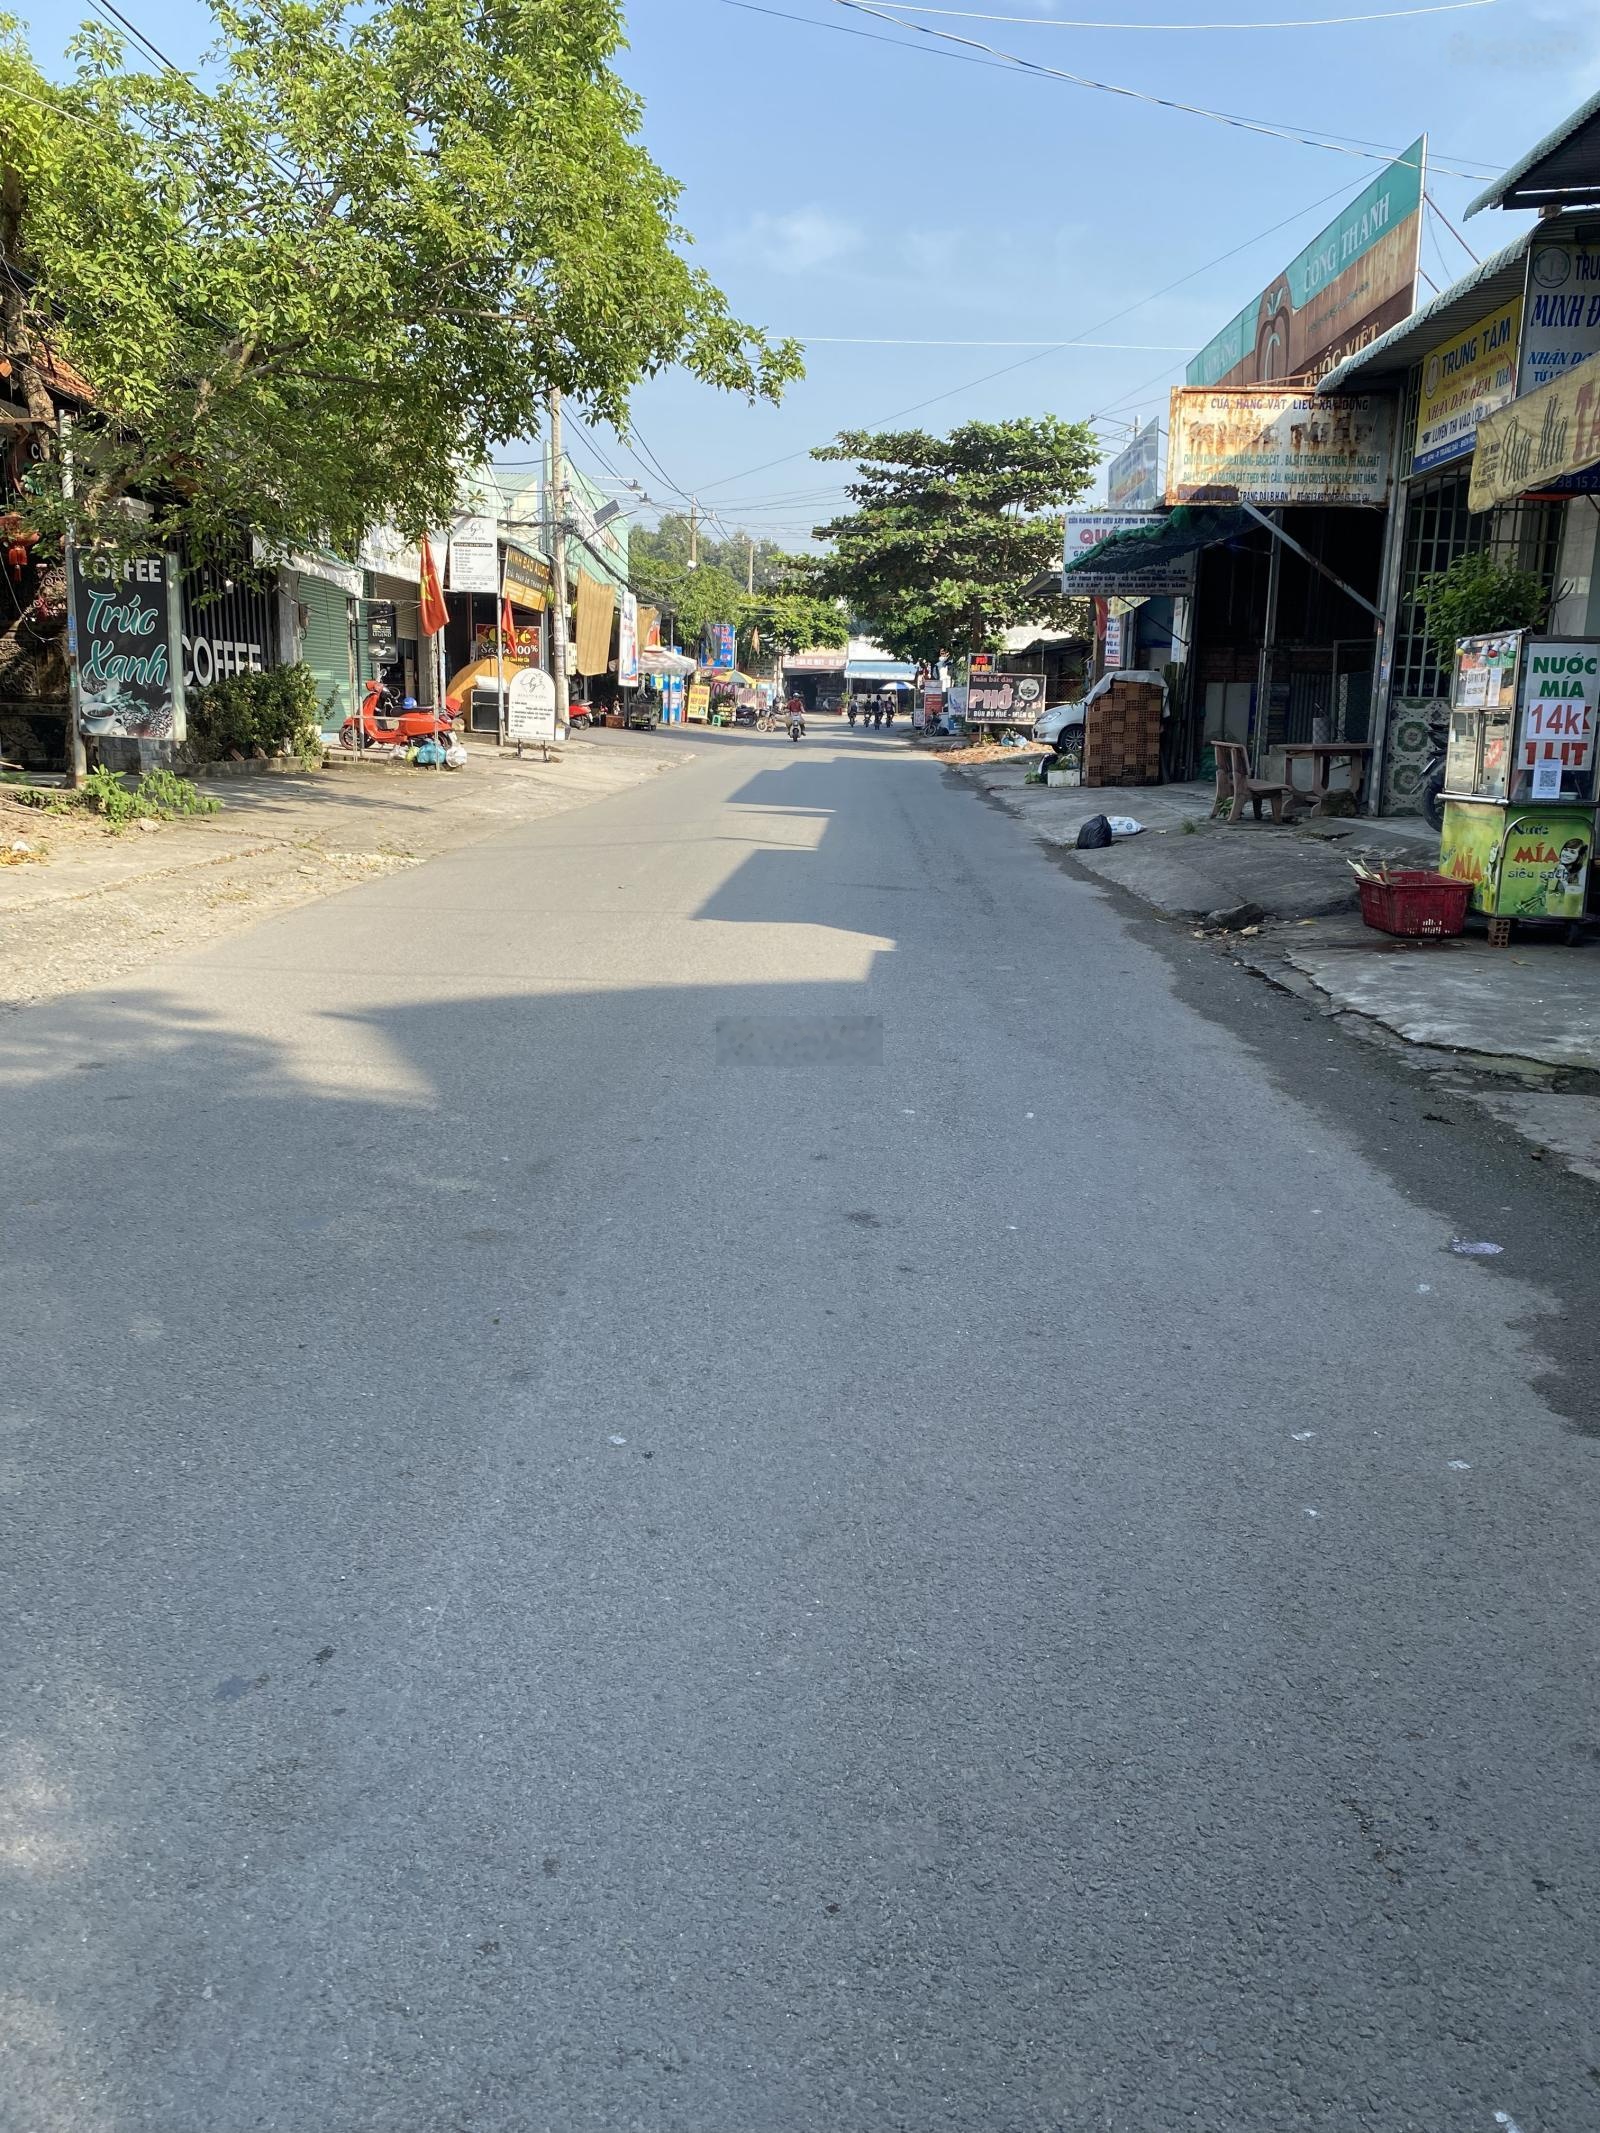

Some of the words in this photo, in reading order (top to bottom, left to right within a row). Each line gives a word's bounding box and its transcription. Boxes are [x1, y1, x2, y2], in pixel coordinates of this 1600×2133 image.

[1530, 294, 1585, 328] MINH
[1442, 335, 1478, 378] TRUNG
[1482, 316, 1511, 356] TÂM
[87, 589, 159, 636] Trúc
[82, 639, 168, 687] Xanh
[1532, 652, 1598, 675] NƯỚC
[968, 683, 1015, 710] PHỞ
[1539, 675, 1585, 698] MÍA
[1531, 703, 1582, 735] 14k
[1525, 741, 1537, 766] 1
[1513, 841, 1560, 865] MÍA
[1507, 867, 1534, 879] siêu
